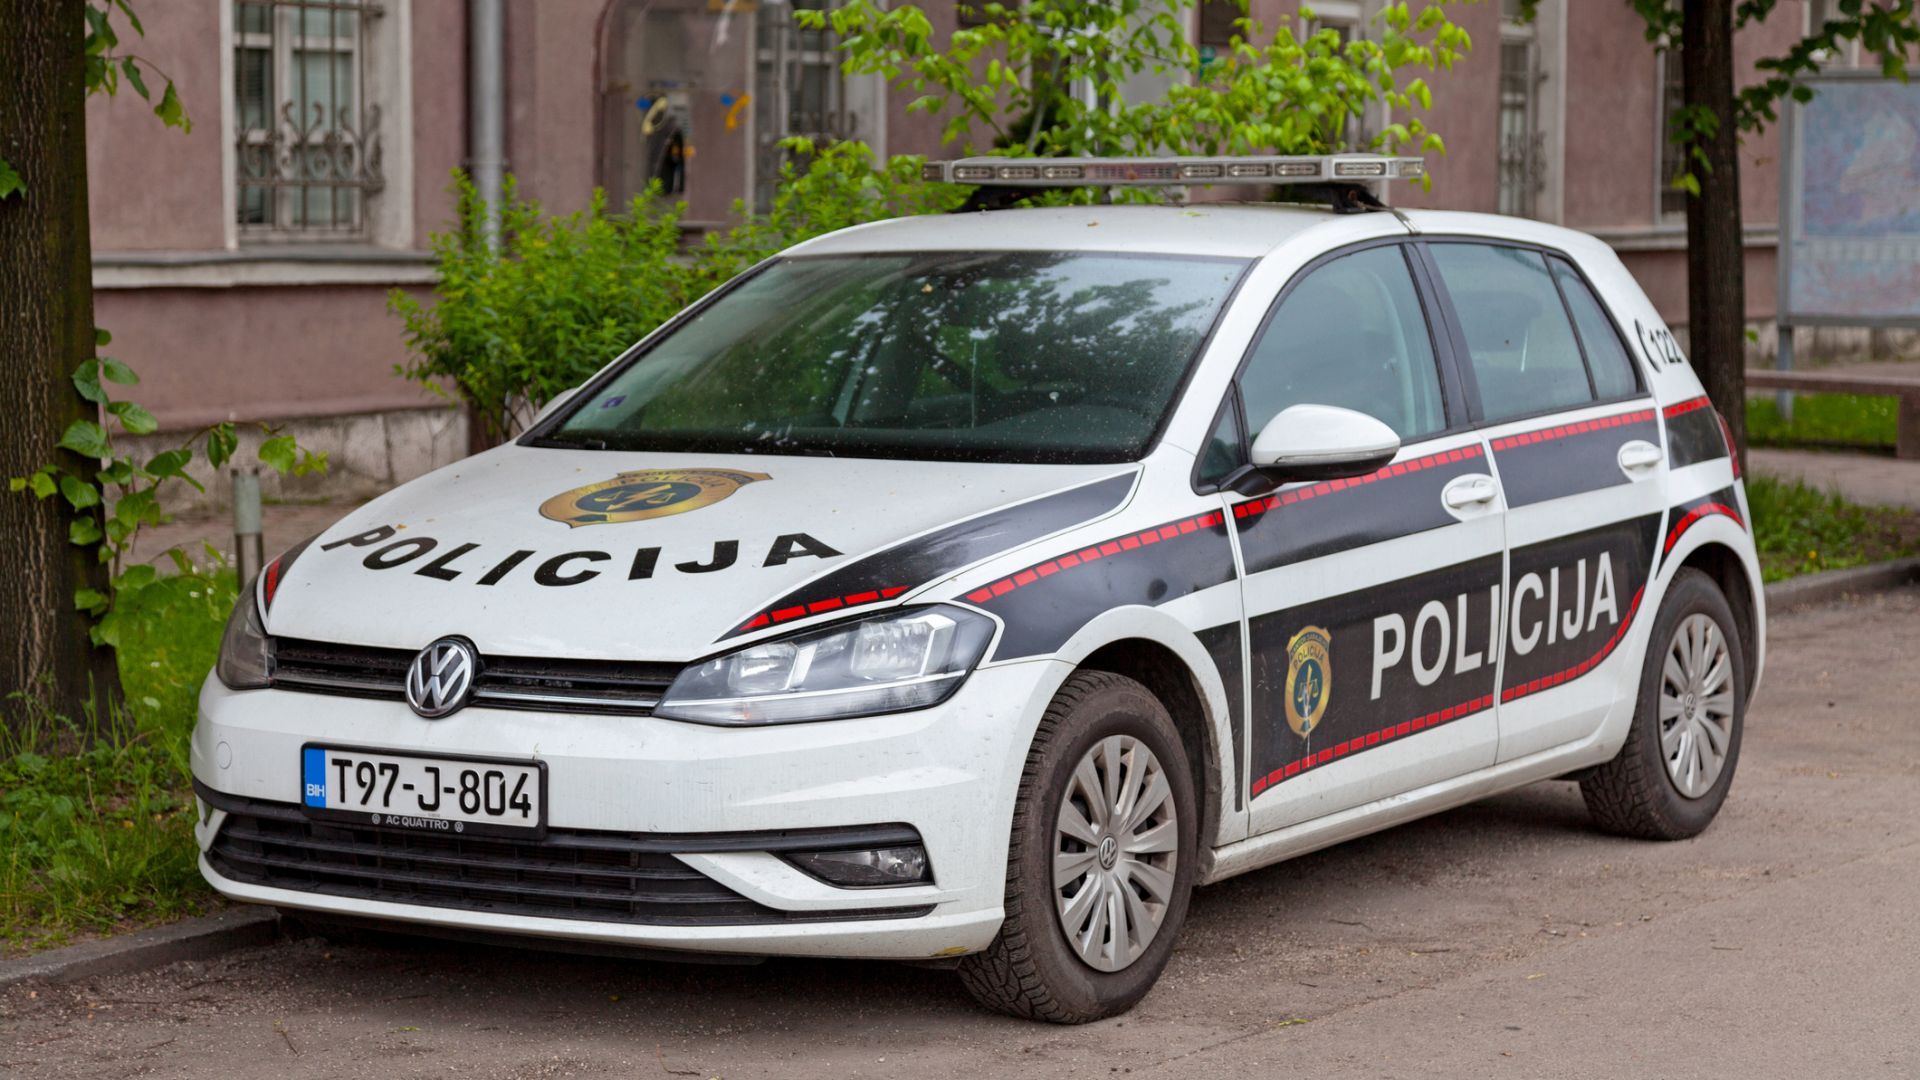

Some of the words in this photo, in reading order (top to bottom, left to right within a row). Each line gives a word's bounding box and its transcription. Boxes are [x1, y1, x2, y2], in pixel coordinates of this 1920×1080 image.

[1649, 329, 1682, 363] 122
[320, 524, 845, 587] POLICIJA
[1370, 551, 1619, 700] POLICIJA
[306, 783, 325, 797] BIH
[331, 758, 532, 818] T97-J-804
[385, 815, 400, 825] AC
[401, 816, 449, 830] QUATTRO
